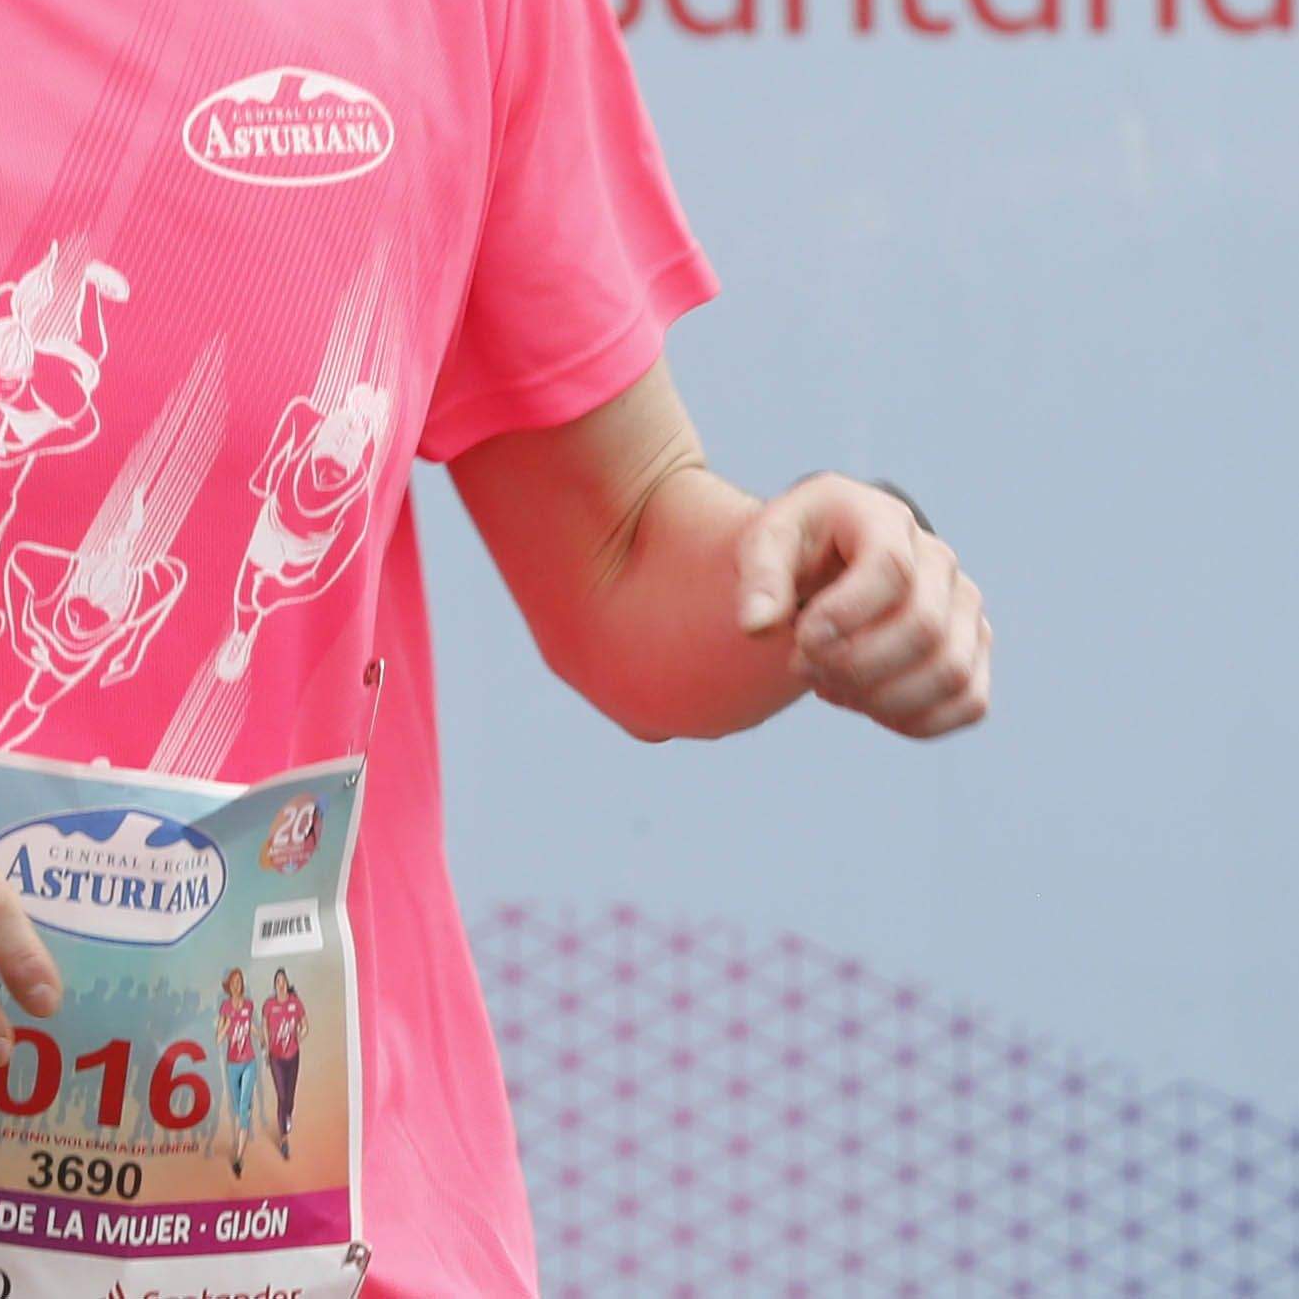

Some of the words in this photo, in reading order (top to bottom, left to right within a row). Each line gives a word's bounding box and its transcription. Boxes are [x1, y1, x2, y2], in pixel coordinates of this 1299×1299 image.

[205, 112, 382, 160] ASTURIANA
[5, 844, 211, 914] ASTURIANA
[27, 1151, 143, 1201] 3690
[46, 1209, 85, 1241] LA
[96, 1213, 190, 1246] MUJER
[215, 1201, 289, 1243] GIJÓN
